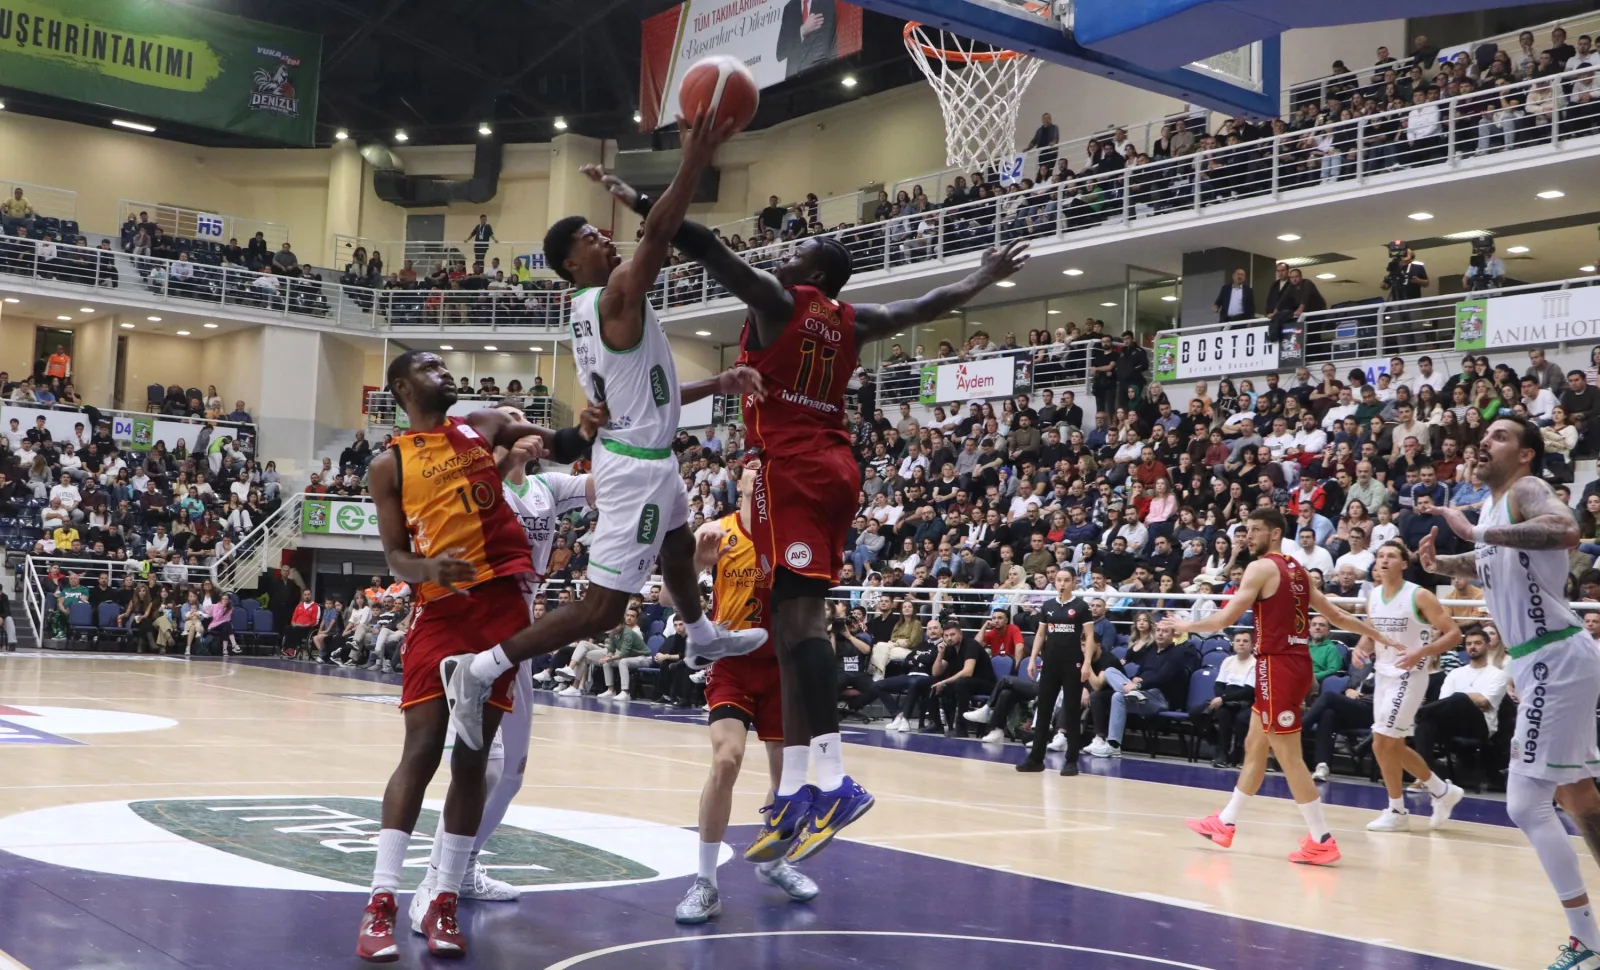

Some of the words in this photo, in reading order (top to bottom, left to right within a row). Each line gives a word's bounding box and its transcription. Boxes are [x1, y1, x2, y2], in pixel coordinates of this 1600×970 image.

[694, 13, 711, 34] TÜM
[198, 216, 222, 237] H5
[804, 317, 842, 343] GSYAD
[1491, 324, 1547, 345] ANIM
[1181, 331, 1273, 364] BOSTON
[794, 338, 838, 402] 11
[956, 374, 995, 393] Aydem
[115, 421, 132, 435] D4
[456, 480, 495, 514] 10
[641, 508, 655, 540] ABALI
[790, 550, 808, 560] AVS
[744, 597, 763, 623] 2
